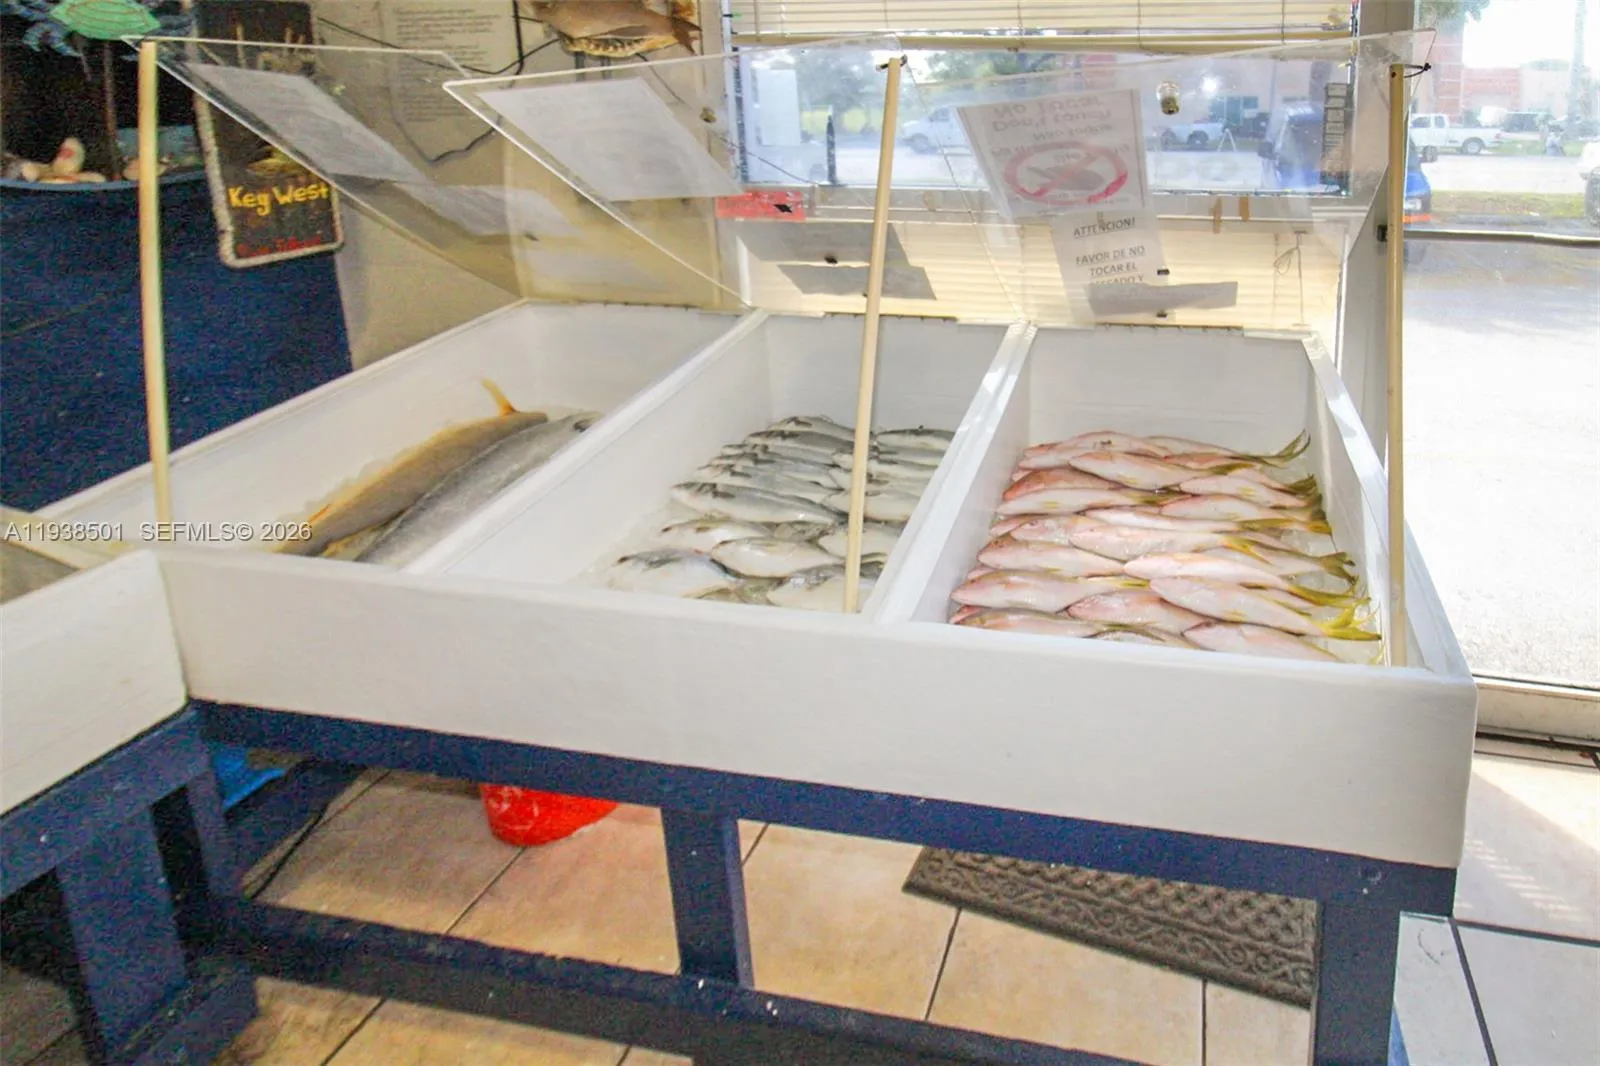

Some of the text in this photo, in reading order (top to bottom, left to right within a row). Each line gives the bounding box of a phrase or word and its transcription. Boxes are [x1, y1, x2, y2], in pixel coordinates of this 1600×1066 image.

[228, 183, 329, 216] Key West
[1075, 245, 1145, 266] FAVOR DE NO
[1090, 261, 1137, 277] TOCAR EL
